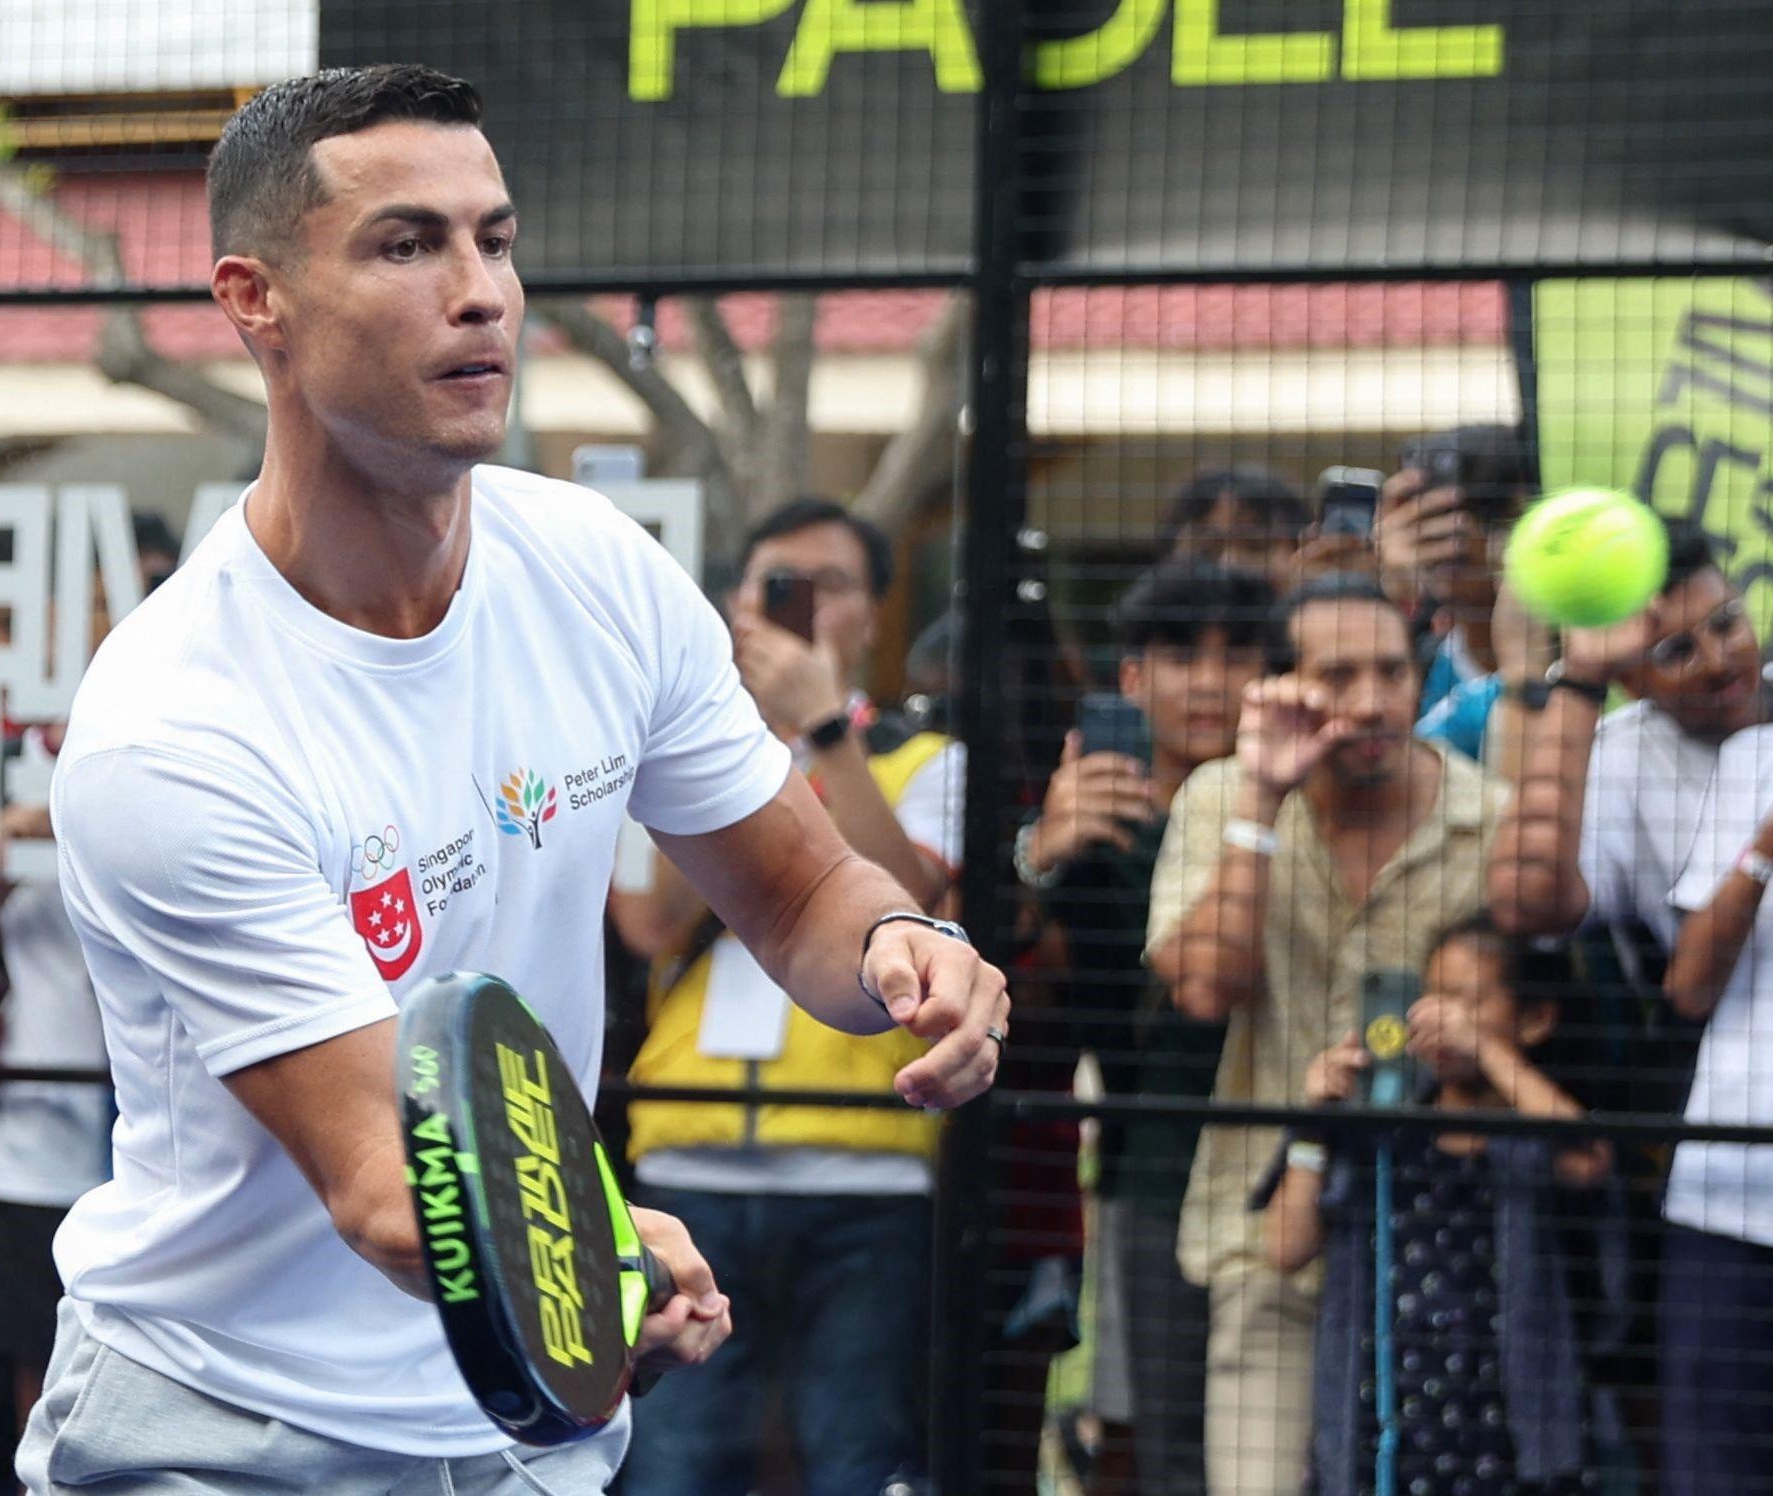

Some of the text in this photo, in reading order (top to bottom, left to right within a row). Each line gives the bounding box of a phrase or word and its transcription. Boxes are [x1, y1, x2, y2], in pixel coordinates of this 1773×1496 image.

[564, 753, 626, 791] Peter Lim
[417, 827, 474, 874] Singapor
[421, 852, 473, 895] Olymic
[412, 1112, 480, 1303] KUIKMA
